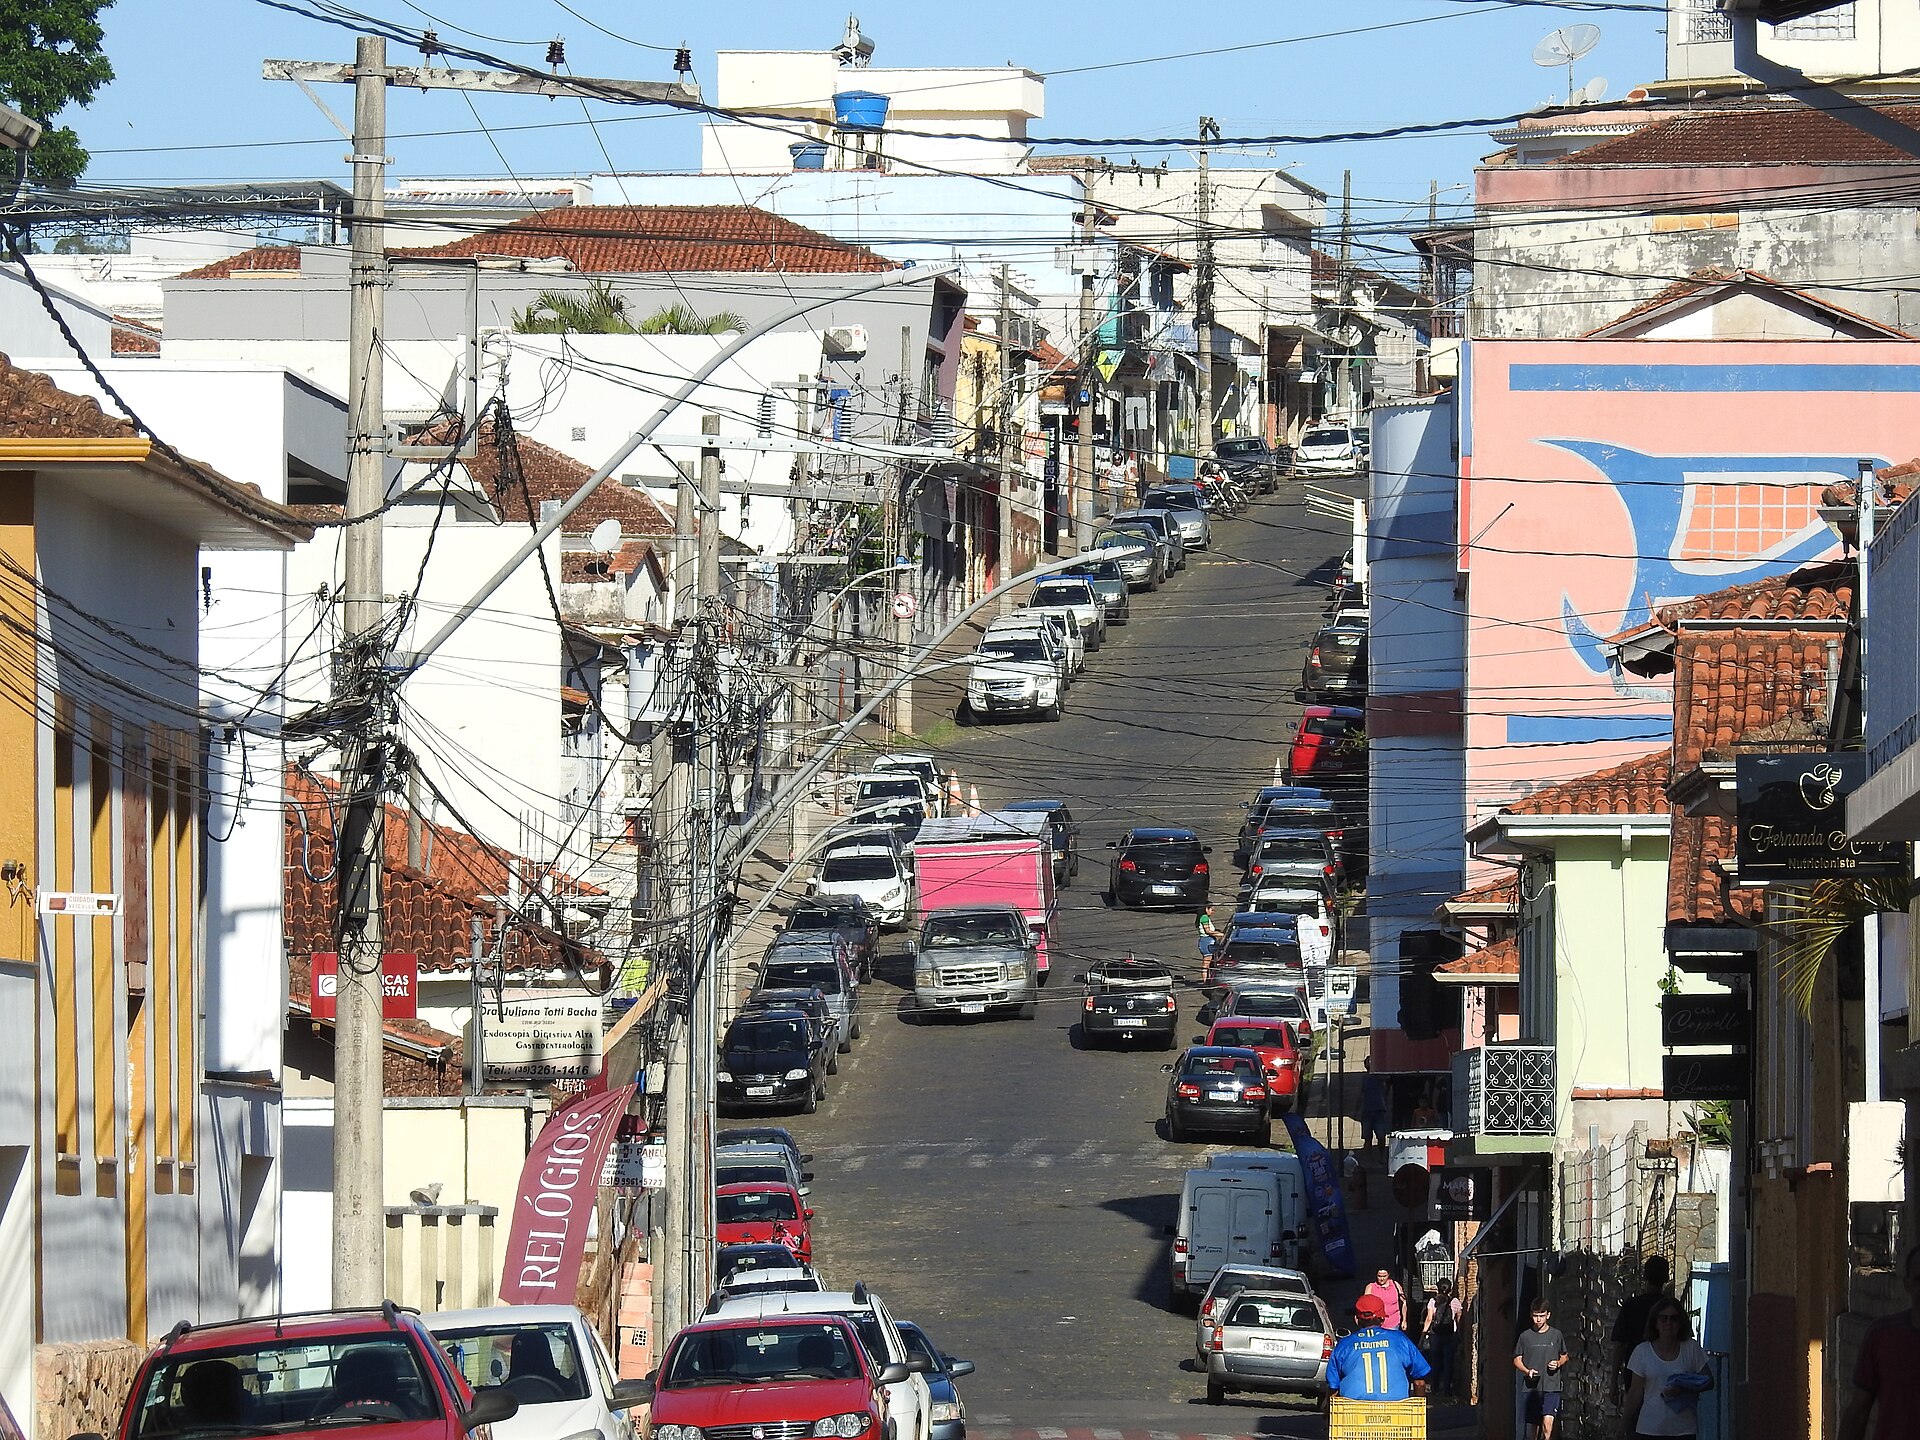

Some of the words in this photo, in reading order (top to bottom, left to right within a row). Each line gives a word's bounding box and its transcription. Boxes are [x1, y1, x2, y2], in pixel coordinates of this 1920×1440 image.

[1748, 824, 1825, 853] Fernanda
[1787, 857, 1857, 870] Nutricionista
[382, 974, 409, 986] ICAS
[503, 1006, 540, 1017] Juliana
[544, 1007, 564, 1017] Totti
[567, 1006, 598, 1017] Bacha
[1694, 1007, 1715, 1015] CASA
[484, 1029, 530, 1039] Endoscopia
[533, 1029, 572, 1040] Digestiva
[575, 1029, 593, 1038] Alta
[515, 1041, 593, 1051] Gastroenterologia
[487, 1065, 511, 1075] Tel.:
[514, 1065, 590, 1075] (35)3261-1416
[636, 1148, 664, 1158] PANEL
[518, 1111, 602, 1289] RELÓGIOS
[1362, 1351, 1389, 1394] 11
